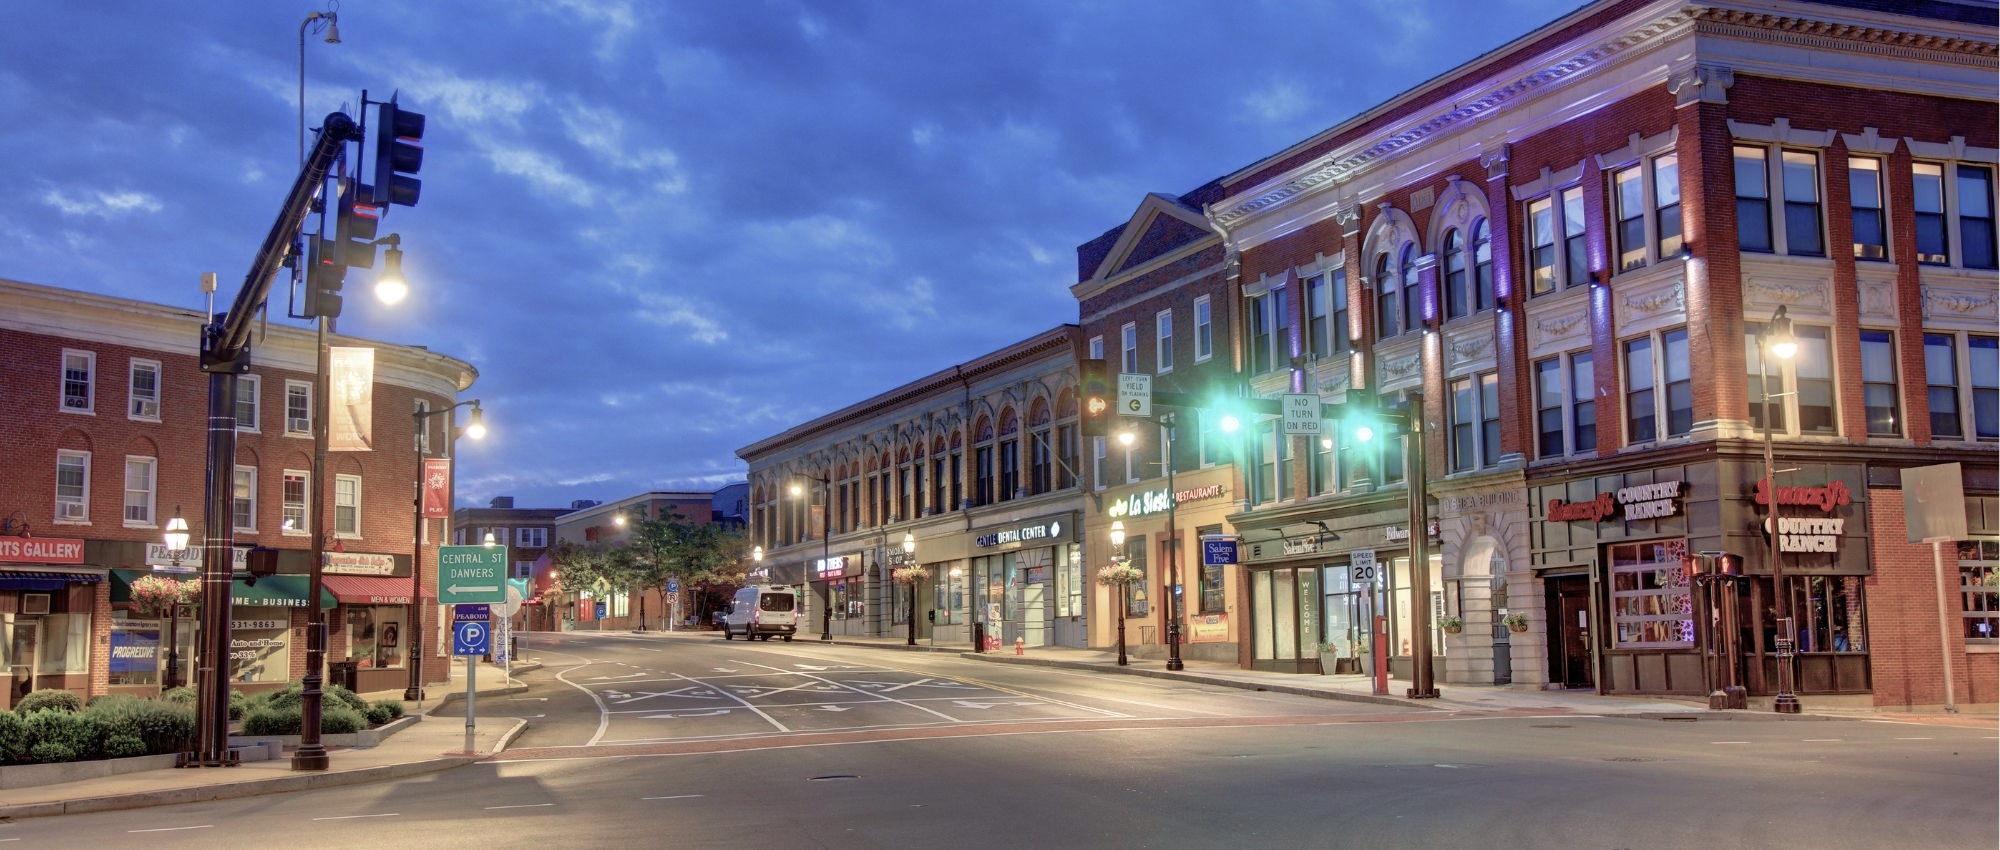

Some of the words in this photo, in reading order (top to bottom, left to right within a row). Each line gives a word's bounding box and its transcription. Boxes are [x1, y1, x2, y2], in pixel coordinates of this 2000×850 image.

[1126, 382, 1144, 390] YIELD
[1294, 398, 1308, 407] NO
[1291, 410, 1313, 418] TURN
[1286, 421, 1298, 430] ON
[1301, 421, 1318, 430] RED
[1479, 490, 1520, 507] BUILDING
[1617, 480, 1680, 504] COUNTRY
[1129, 493, 1142, 516] La
[1175, 485, 1219, 503] RESTAURANTE
[1624, 498, 1674, 520] RANCH
[1765, 517, 1844, 535] COUNTRY
[975, 533, 997, 548] GENTLE
[998, 529, 1021, 544] DENTAL
[1021, 525, 1046, 540] CENTER
[1386, 527, 1409, 541] Edwar
[0, 541, 20, 557] RTS
[24, 541, 81, 558] GALLERY
[1209, 543, 1233, 553] Salem
[1283, 541, 1303, 556] Salem
[1779, 534, 1838, 553] RANCH
[149, 545, 203, 561] PEAOD
[442, 554, 483, 564] CENTRAL
[491, 553, 503, 563] ST
[1213, 553, 1230, 563] Five
[451, 568, 494, 579] DANVERS
[1355, 566, 1374, 579] 20
[231, 597, 250, 605] ME
[370, 595, 384, 603] MEN
[389, 596, 410, 604] WOMEN
[1302, 581, 1310, 633] WELCOME
[231, 621, 275, 629] 531-9863
[467, 628, 480, 642] P
[249, 639, 263, 647] and
[263, 639, 285, 648] Home
[112, 646, 156, 659] PROGRESSIVE
